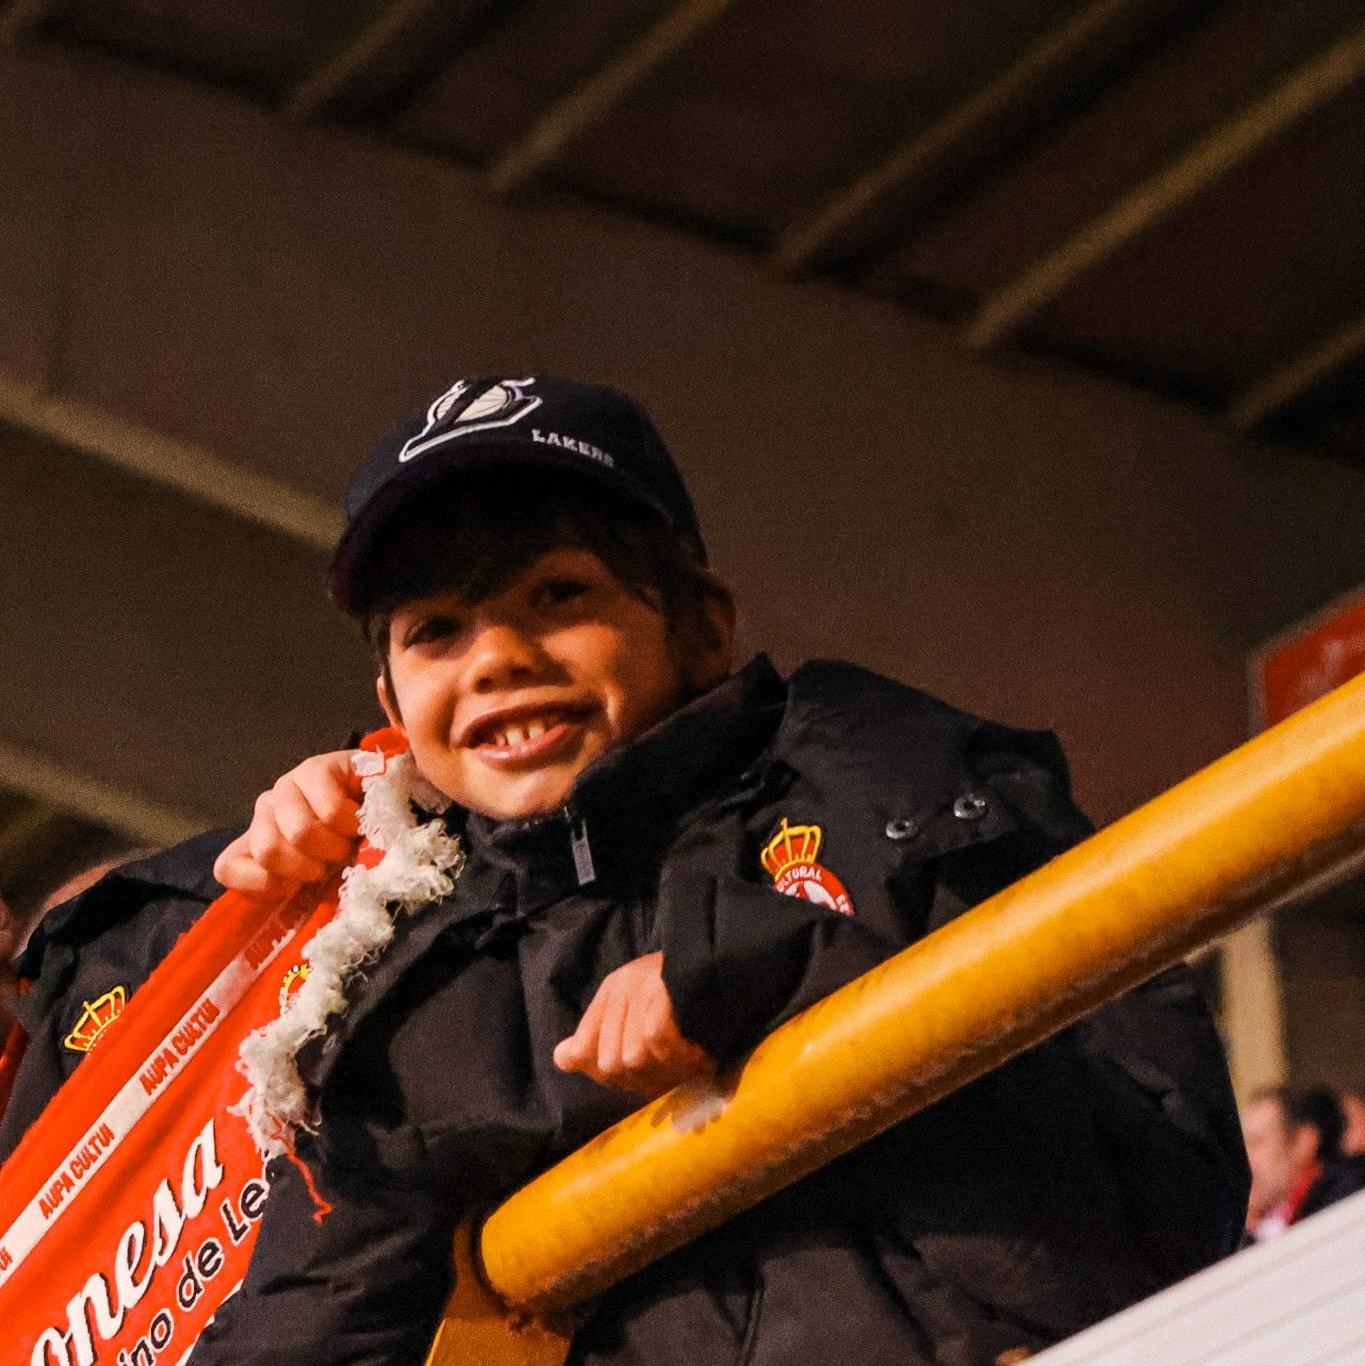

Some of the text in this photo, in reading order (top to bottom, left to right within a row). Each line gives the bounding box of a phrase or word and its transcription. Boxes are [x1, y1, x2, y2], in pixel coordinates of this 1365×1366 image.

[531, 427, 615, 469] LAKERS
[138, 1046, 180, 1097] AUPA
[38, 1170, 76, 1221] AUPA
[176, 1236, 225, 1311] de
